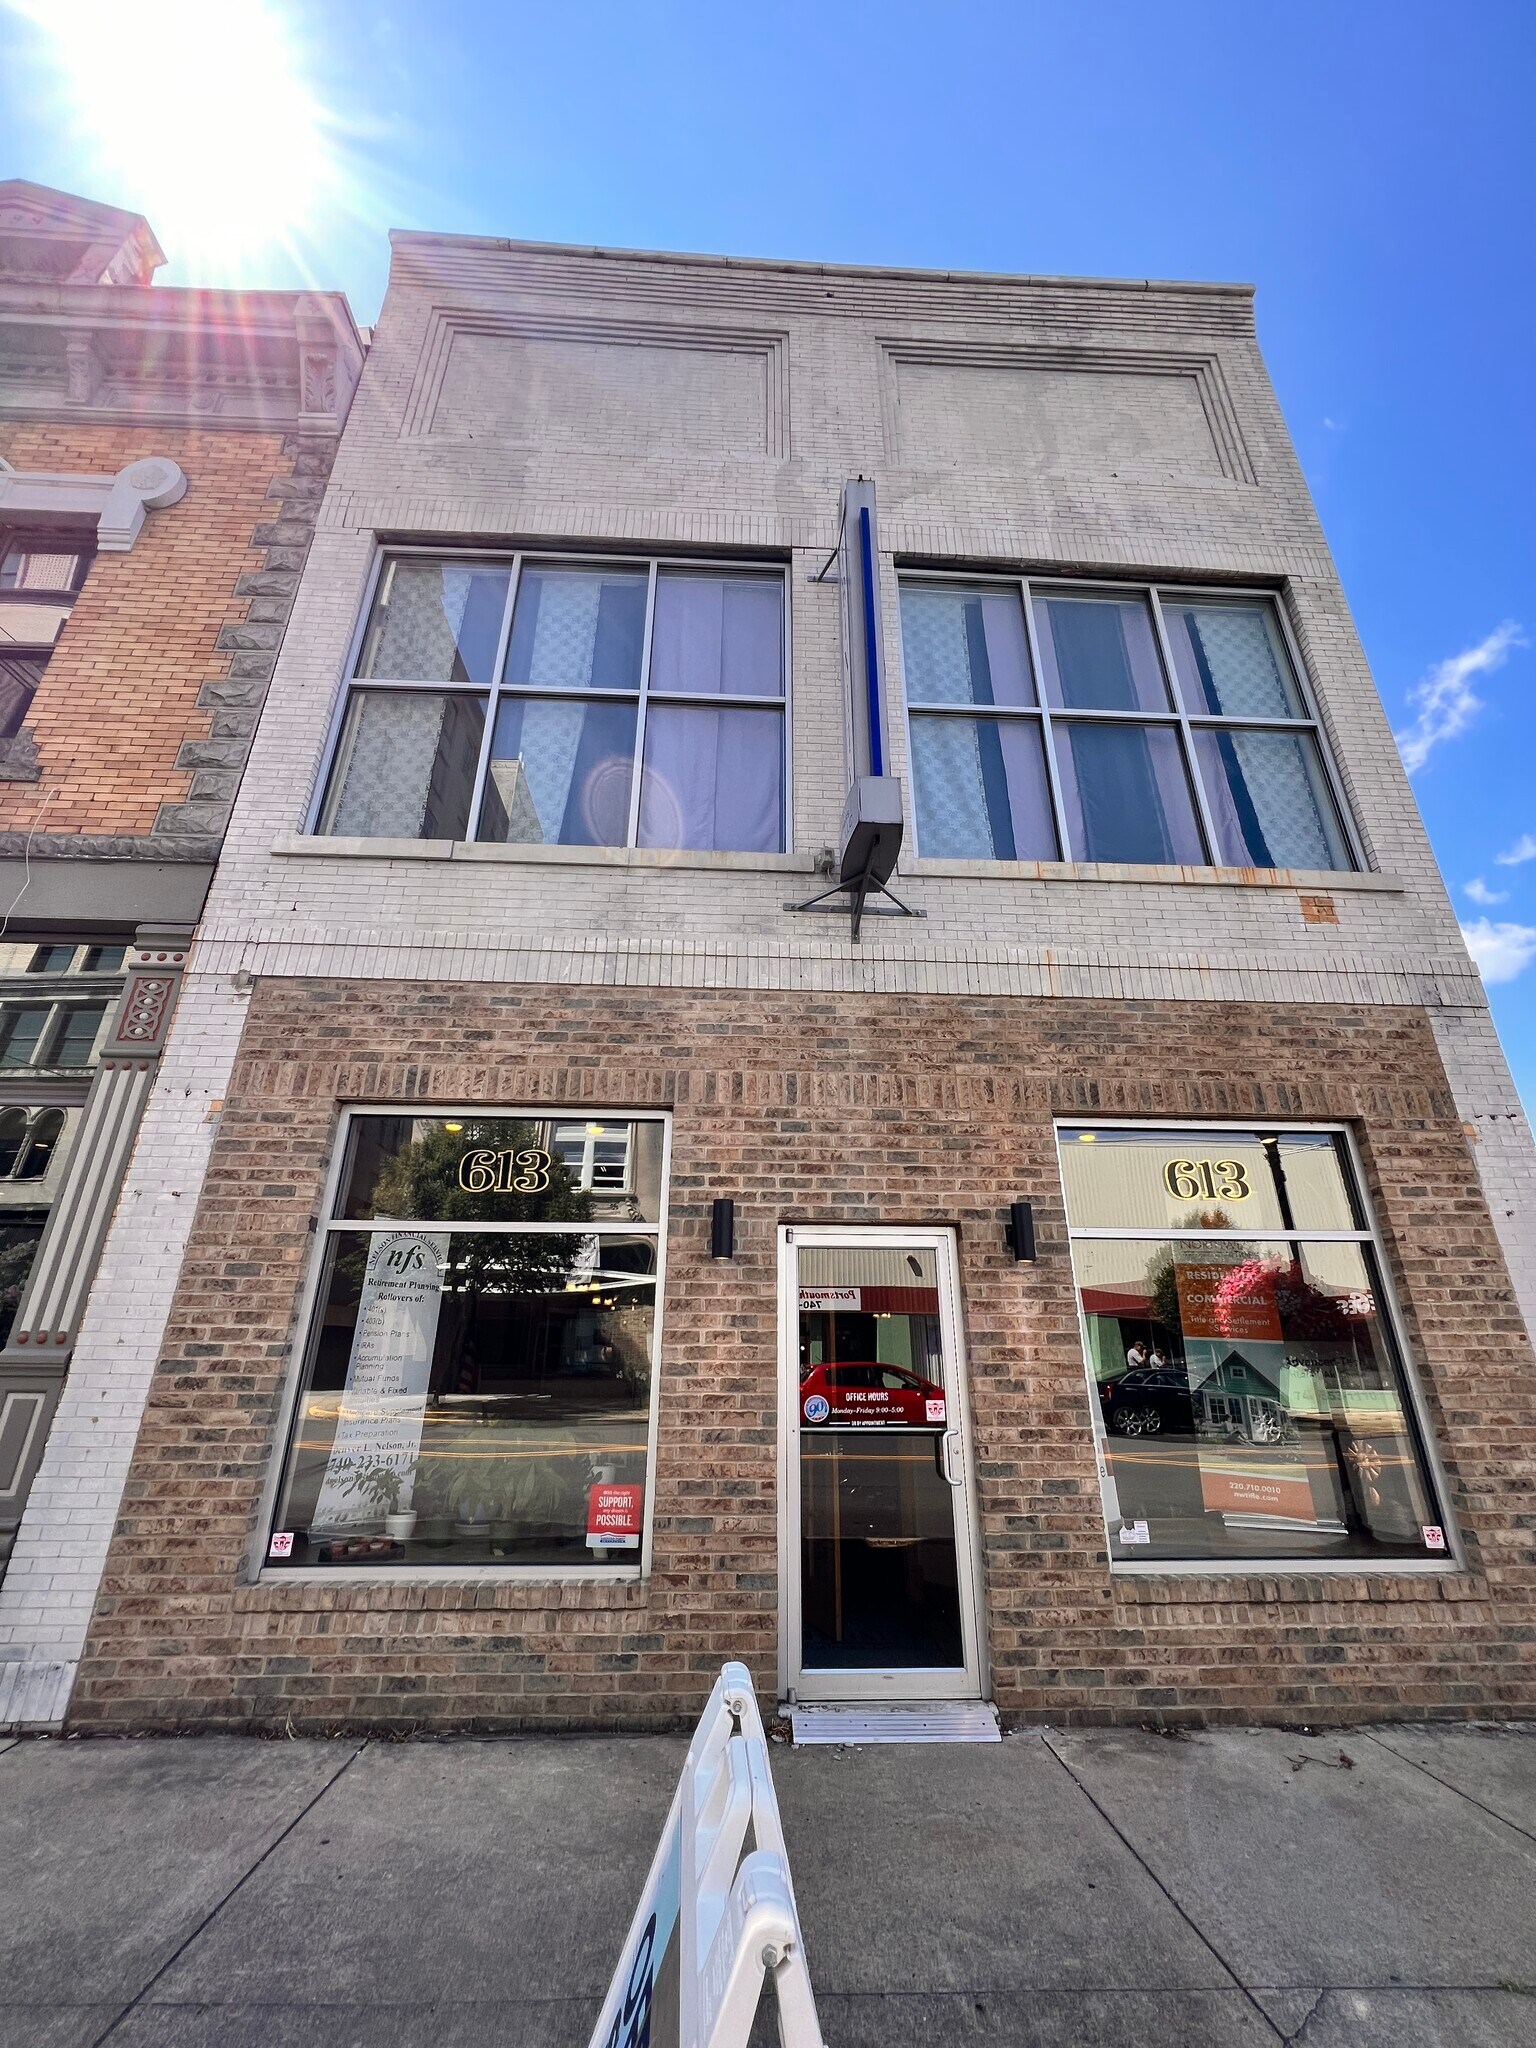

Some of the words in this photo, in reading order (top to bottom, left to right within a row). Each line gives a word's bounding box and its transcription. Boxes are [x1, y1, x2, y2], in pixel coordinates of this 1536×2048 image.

[459, 1149, 551, 1193] 613
[1163, 1159, 1251, 1201] 613
[369, 1238, 391, 1266] NELSON
[386, 1245, 425, 1275] nfs
[368, 1278, 407, 1289] Retirement
[408, 1281, 440, 1292] Planning
[378, 1292, 413, 1302] Rollovers
[415, 1294, 425, 1303] of:
[1190, 1315, 1206, 1323] Title
[1227, 1315, 1270, 1326] Settlement
[363, 1329, 388, 1337] Pension
[355, 1362, 384, 1371] Planning
[387, 1386, 408, 1394] Fixed
[845, 1392, 866, 1402] OFFICE
[867, 1392, 888, 1402] HOURS
[341, 1431, 353, 1439] Tax
[355, 1429, 399, 1439] Preparation
[407, 1440, 417, 1449] Jr.
